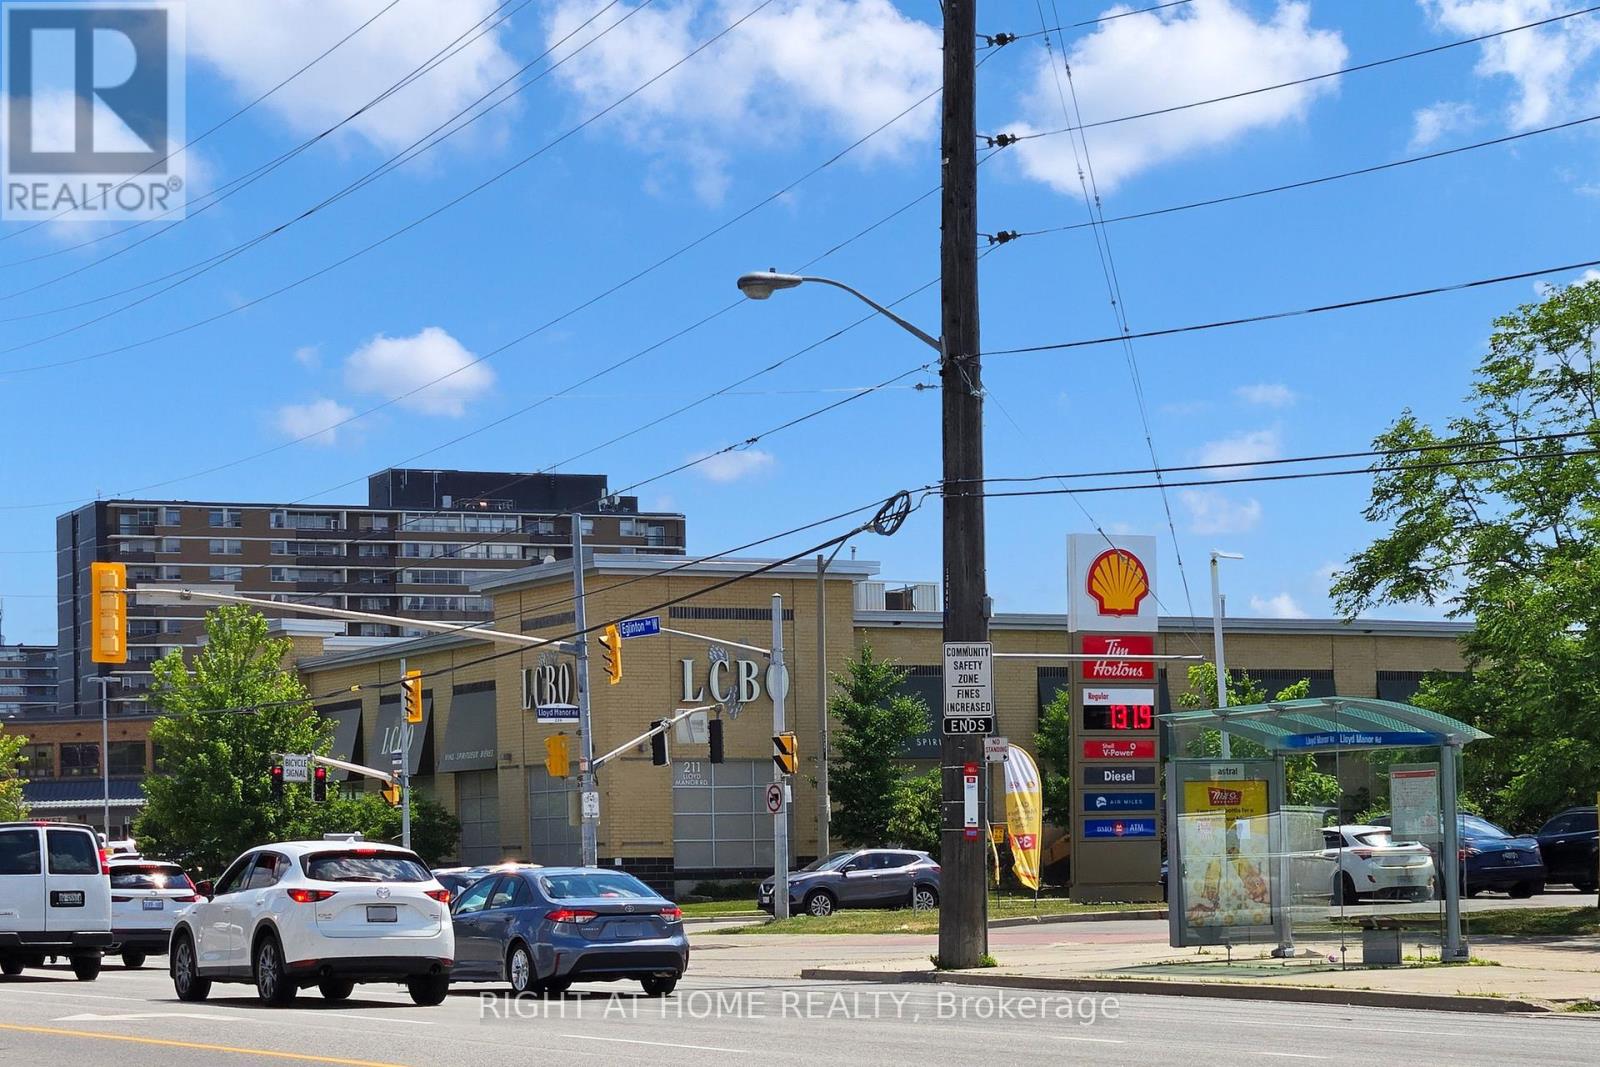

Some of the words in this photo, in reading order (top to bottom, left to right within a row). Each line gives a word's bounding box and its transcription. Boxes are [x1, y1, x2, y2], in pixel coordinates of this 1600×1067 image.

[621, 621, 645, 636] Eglinton
[651, 618, 658, 630] W
[946, 647, 989, 657] COMMUNITY
[1105, 639, 1129, 656] Tim
[953, 660, 983, 670] SAFETY
[1093, 660, 1143, 677] Hortons
[958, 674, 979, 684] ZONE
[521, 662, 570, 711] LCBO
[957, 688, 980, 699] FINES
[1087, 692, 1109, 701] Regular
[538, 709, 554, 717] Lloyd
[947, 702, 991, 713] INCREASED
[951, 720, 985, 732] ENDS
[1340, 733, 1355, 744] Lloyd
[1356, 733, 1374, 743] Manor
[1375, 735, 1382, 743] Rd
[285, 759, 307, 767] BICYCLE
[683, 761, 701, 773] 211
[286, 769, 306, 777] SIGNAL
[1104, 770, 1135, 781] Diesel
[1217, 767, 1238, 775] astral
[1129, 824, 1144, 832] ATM
